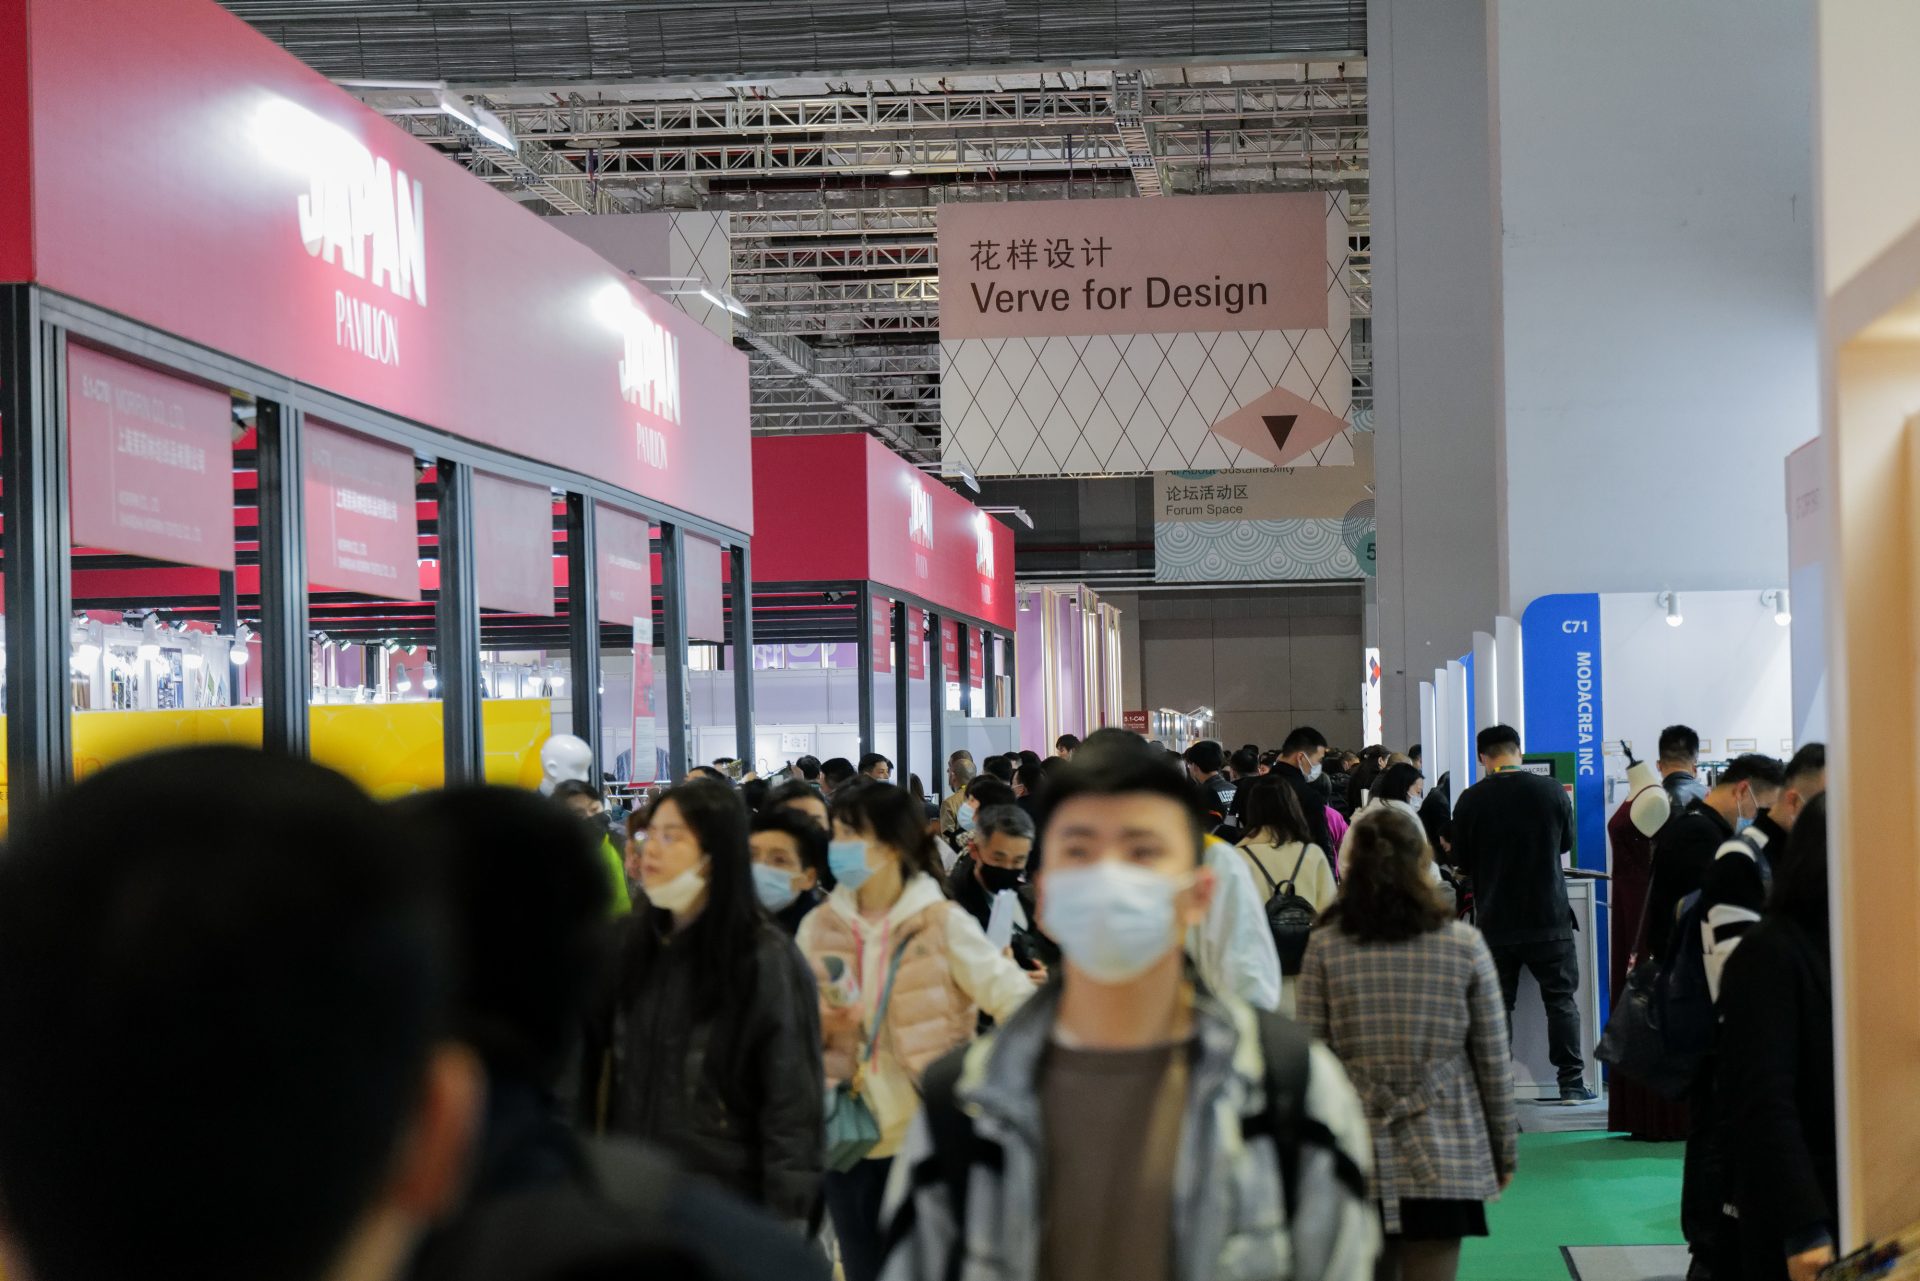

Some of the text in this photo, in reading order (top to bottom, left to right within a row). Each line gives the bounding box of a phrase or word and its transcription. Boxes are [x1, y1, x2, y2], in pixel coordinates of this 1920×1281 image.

[298, 122, 427, 308] JAPAN
[969, 236, 1112, 272] 花样设计
[970, 275, 1267, 314] Verve for Design
[335, 289, 399, 368] PAVILION
[618, 308, 681, 427] JAPAN
[908, 483, 934, 551] JAPAN
[1166, 485, 1249, 502] 论坛活动区
[1166, 503, 1243, 517] Forum Space
[1561, 620, 1588, 634] C71
[1577, 651, 1594, 776] MODACREA INC
